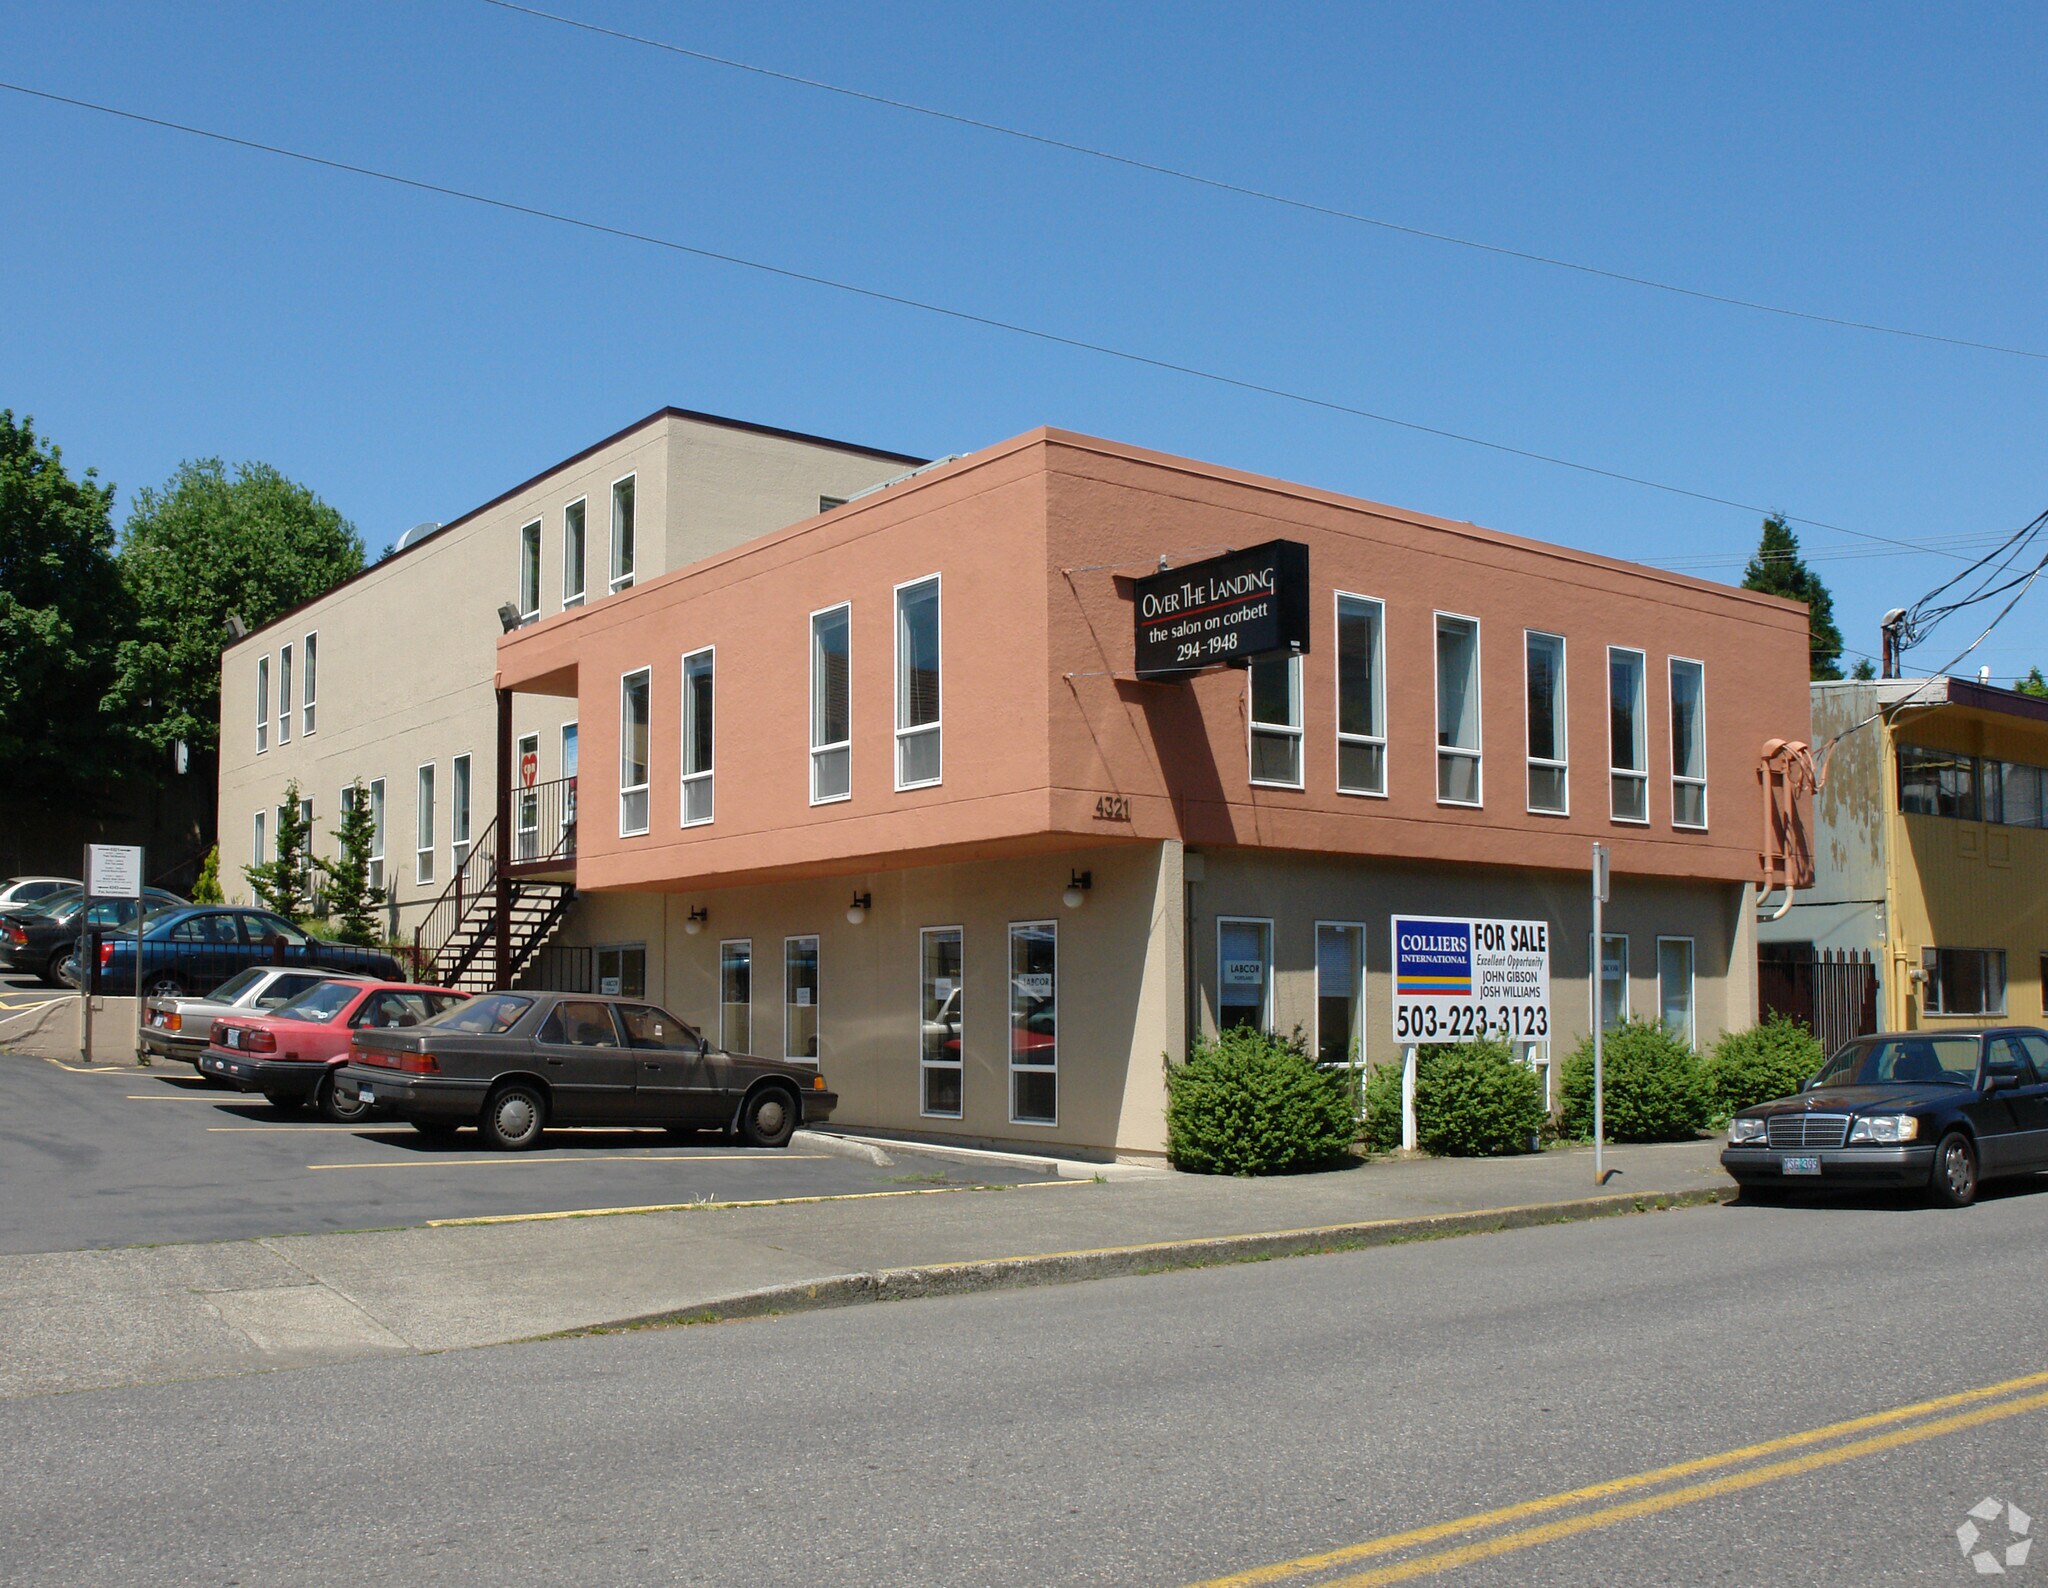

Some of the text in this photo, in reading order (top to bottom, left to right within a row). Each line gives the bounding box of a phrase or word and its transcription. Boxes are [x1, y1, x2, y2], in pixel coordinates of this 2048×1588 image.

[1142, 567, 1275, 618] OVER THE LANDING
[1149, 602, 1268, 644] the salon on corbett
[1176, 632, 1238, 662] 294-1948
[1096, 796, 1129, 818] 4321
[1401, 934, 1467, 952] COLLIERS
[1474, 923, 1546, 952] FOR SALE
[1230, 964, 1260, 973] LABCOR
[1401, 954, 1467, 964] INTERNATIONAL
[1476, 953, 1544, 970] Excellent Opportunity
[1482, 970, 1538, 985] JOHN GIBSON
[1480, 985, 1541, 1000] JOSH WILLIAMS
[1397, 1005, 1548, 1037] 503-223-3123
